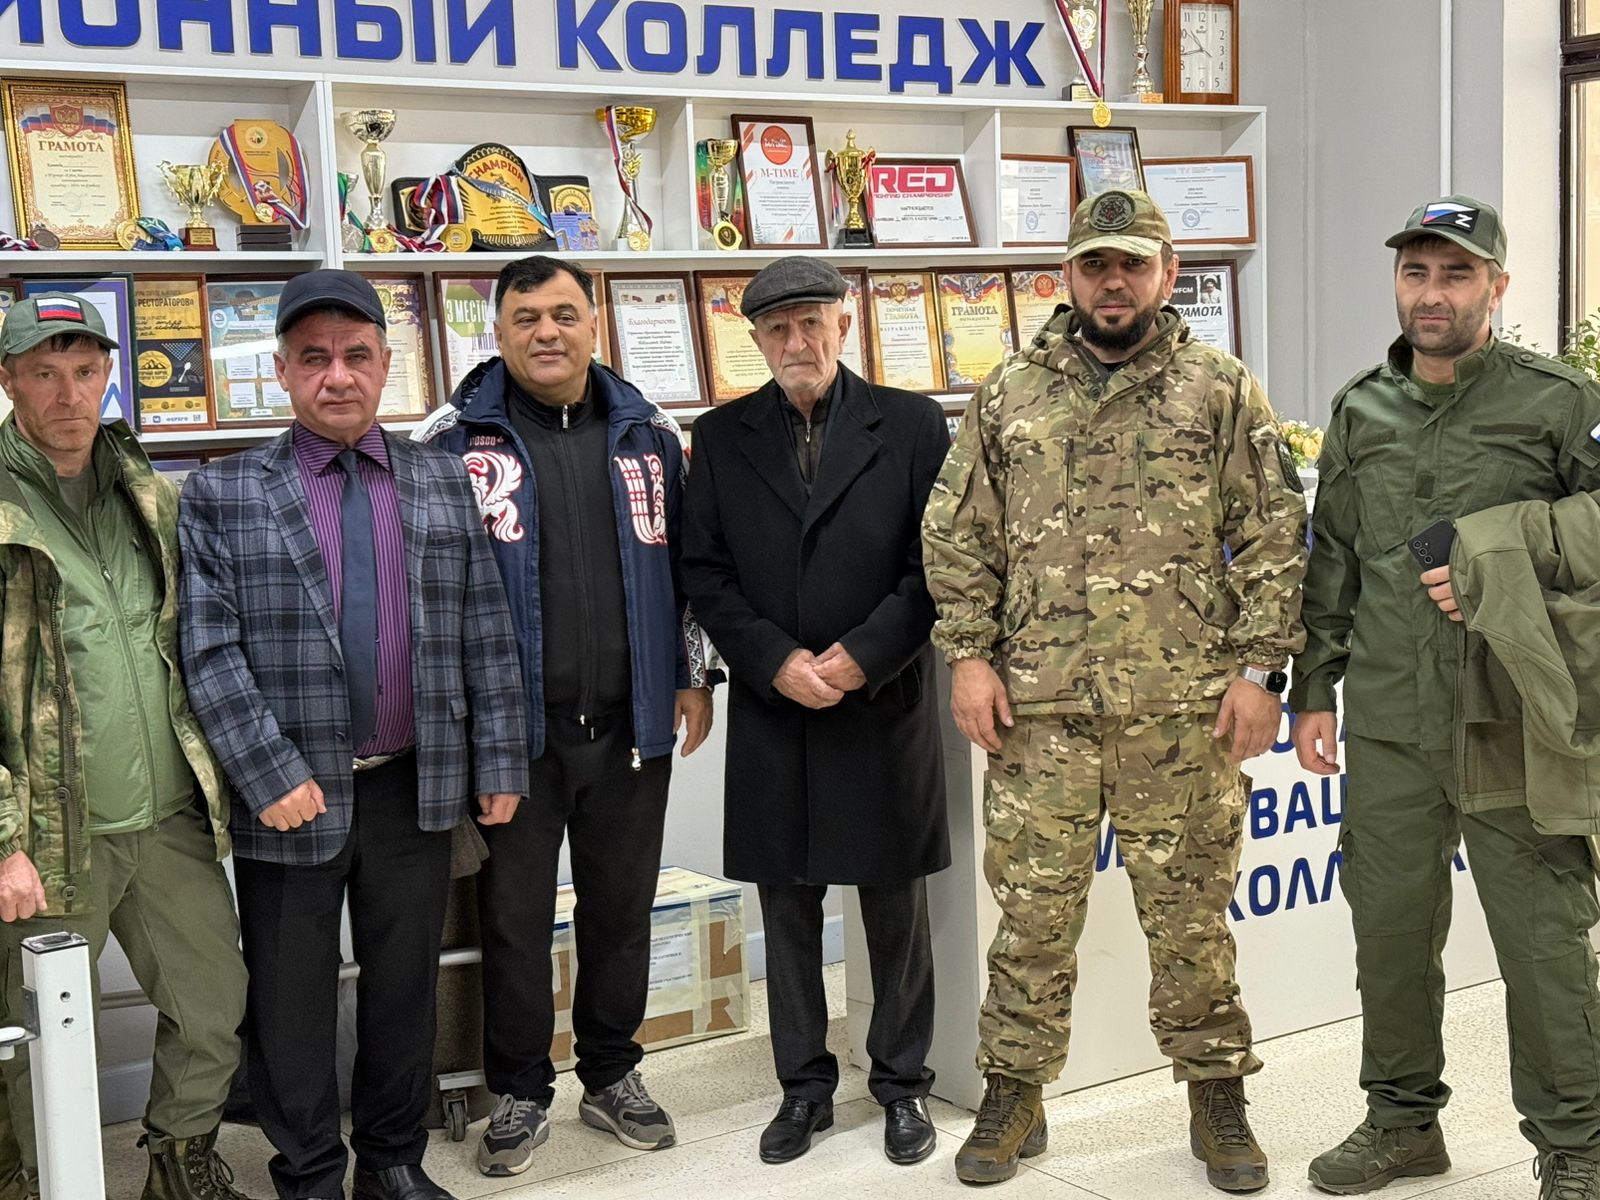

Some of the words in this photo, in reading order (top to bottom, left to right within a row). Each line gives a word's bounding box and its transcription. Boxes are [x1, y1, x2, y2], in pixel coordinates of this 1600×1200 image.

[1198, 12, 1206, 23] 12
[1219, 29, 1225, 40] 2
[556, 0, 1046, 94] КОЛЛЕДЖ
[1219, 45, 1225, 56] 3
[1218, 61, 1224, 71] 4
[1185, 77, 1191, 87] 7
[1198, 78, 1205, 88] 6
[1214, 77, 1220, 88] 5
[38, 140, 105, 152] ГРАМОТА
[467, 158, 525, 183] CHAMPION
[760, 168, 799, 178] M-TIME
[872, 167, 955, 193] RED
[455, 299, 488, 323] МЕСТО
[884, 312, 920, 320] ГРАМОТА
[951, 305, 998, 316] ГРАМОТА
